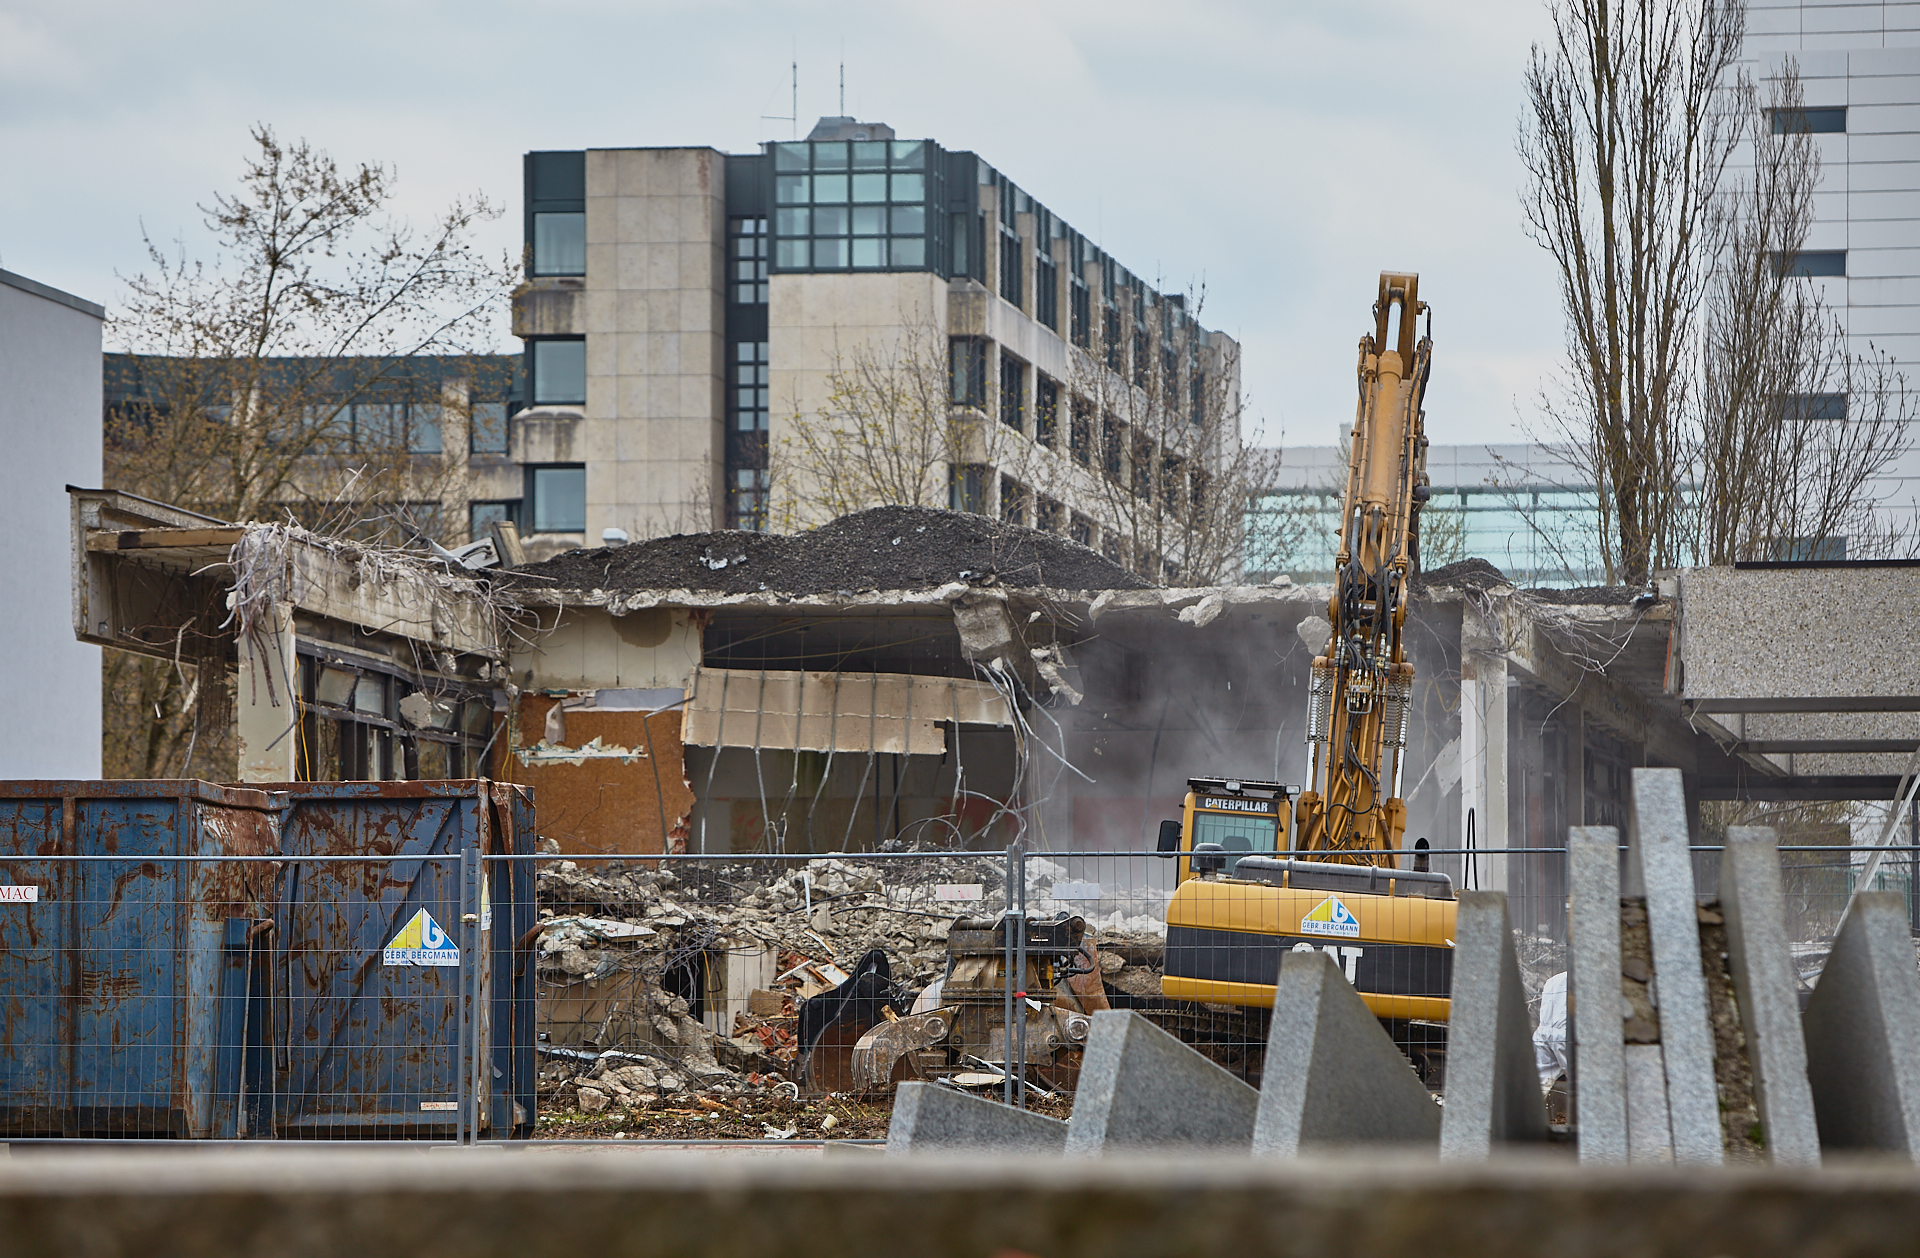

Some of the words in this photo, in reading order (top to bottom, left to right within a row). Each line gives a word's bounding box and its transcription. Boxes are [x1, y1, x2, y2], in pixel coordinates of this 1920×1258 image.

[1205, 797, 1268, 812] CATERPILLAR
[0, 887, 34, 900] MAC
[1322, 923, 1358, 932] BERGMANN
[411, 951, 459, 960] BERGMANN
